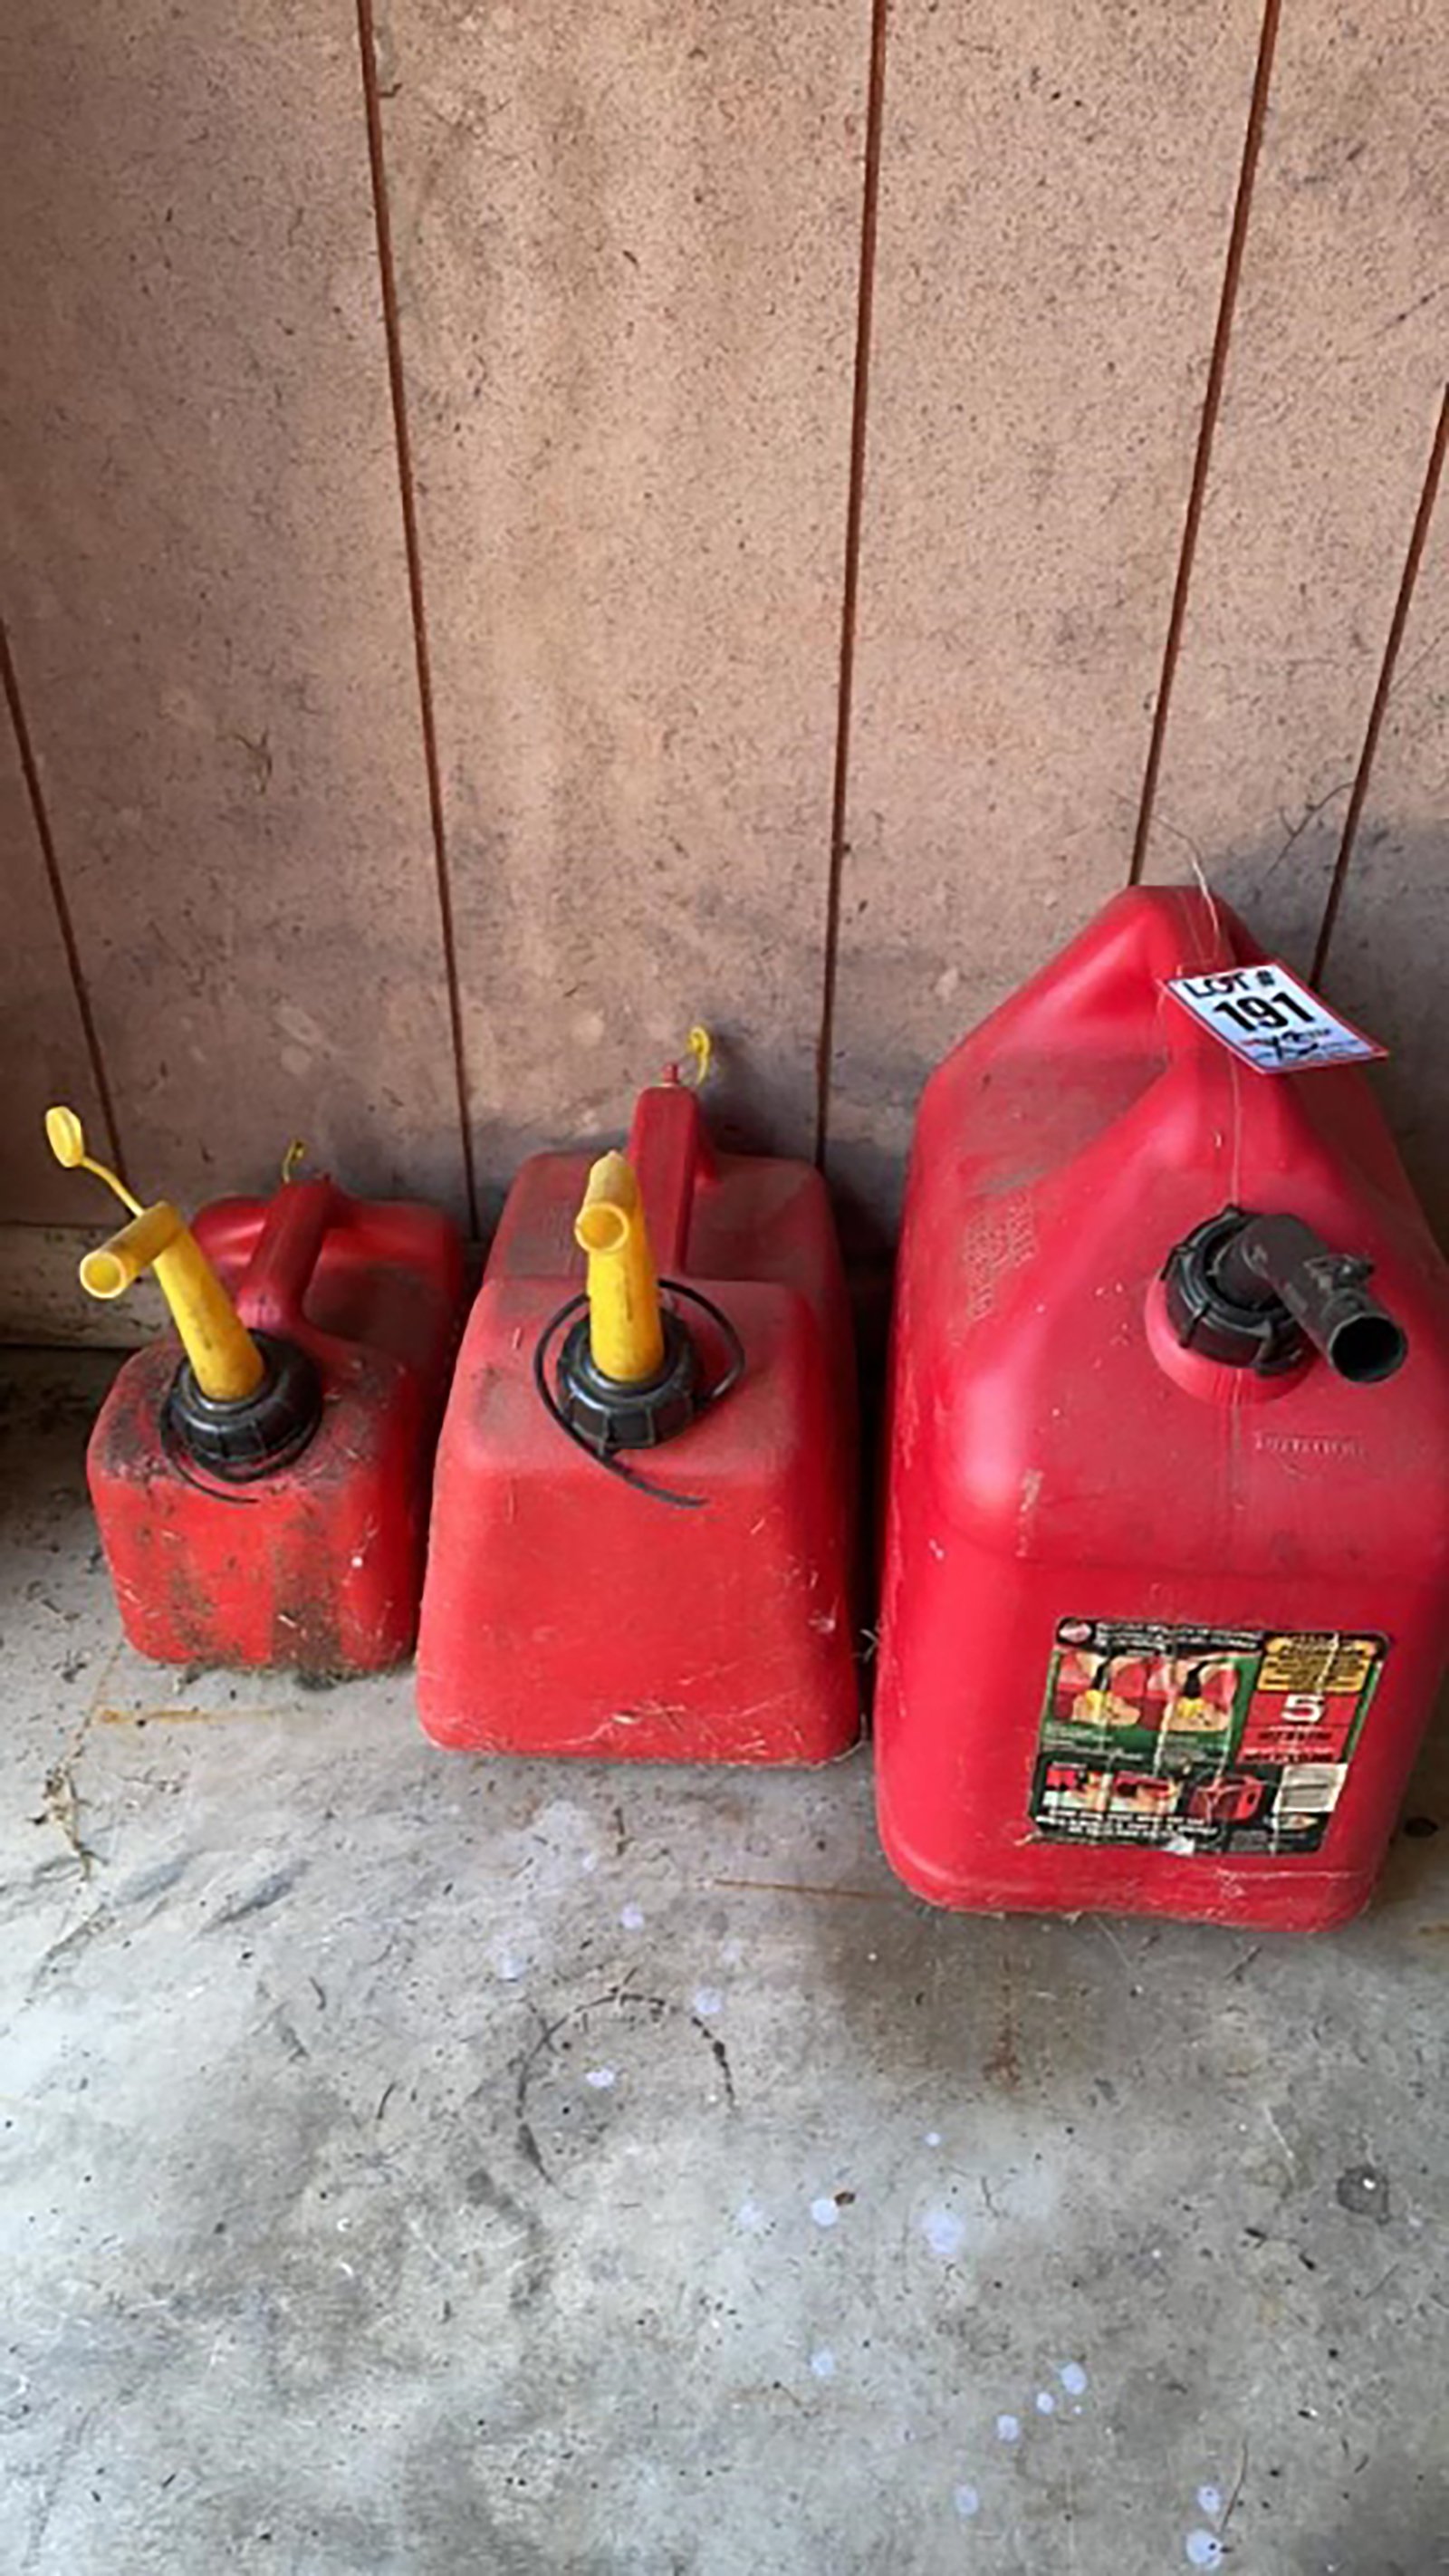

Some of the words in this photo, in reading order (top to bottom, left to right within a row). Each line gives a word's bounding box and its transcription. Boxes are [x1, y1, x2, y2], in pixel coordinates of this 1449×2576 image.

[1183, 972, 1249, 997] LOT
[1214, 992, 1315, 1031] 191
[1281, 1694, 1325, 1722] 5
